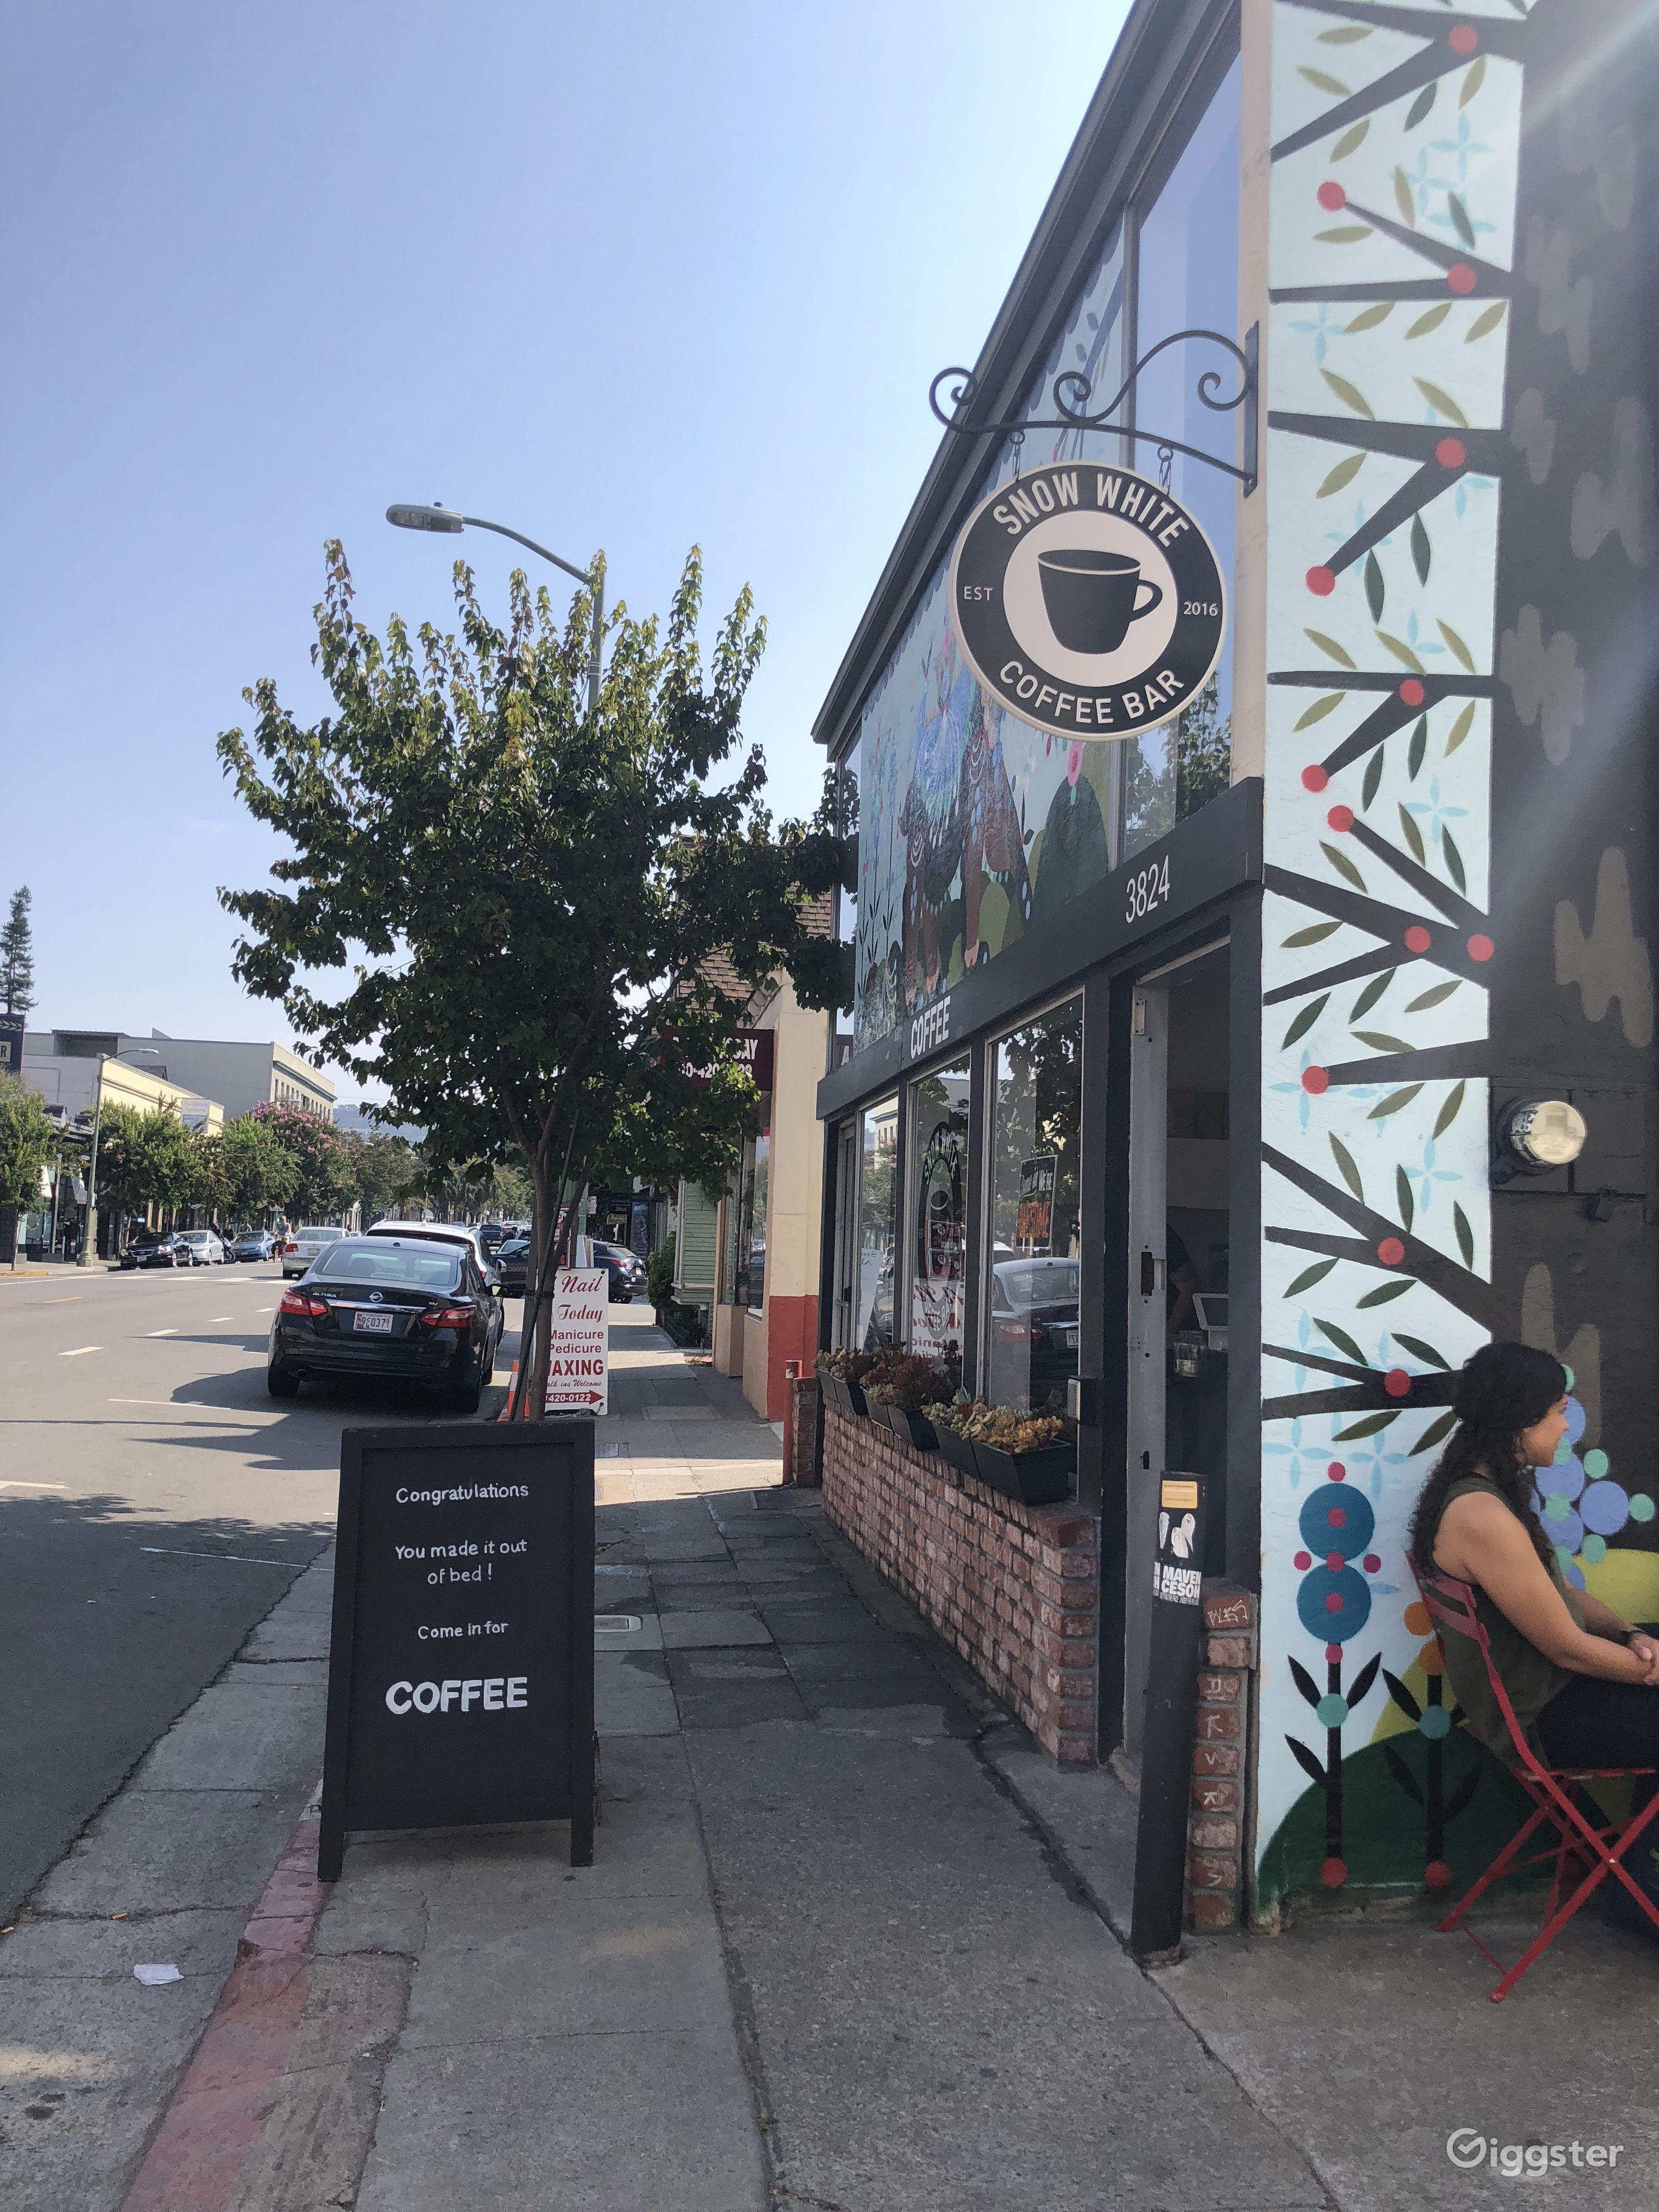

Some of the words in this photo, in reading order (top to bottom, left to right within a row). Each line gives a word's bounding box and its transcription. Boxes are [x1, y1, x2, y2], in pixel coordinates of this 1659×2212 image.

[994, 472, 1079, 535] SNOW
[1097, 473, 1189, 547] WHITE
[964, 586, 993, 601] EST
[1183, 601, 1218, 617] 2016
[1000, 661, 1114, 724] COFFEE
[1122, 669, 1184, 719] BAR
[1126, 855, 1170, 923] 3824
[911, 995, 951, 1059] COFFEE
[562, 1276, 603, 1293] Nail
[557, 1304, 603, 1323] Today
[551, 1329, 604, 1340] Manicure
[550, 1343, 601, 1353] Pedicure
[396, 1482, 529, 1506] Congratulations
[395, 1545, 425, 1560] You
[431, 1540, 478, 1558] made
[484, 1541, 495, 1554] it
[500, 1539, 527, 1554] out
[427, 1568, 445, 1584] of
[1163, 1565, 1201, 1584] MAVEN
[418, 1623, 463, 1639] Come
[468, 1623, 481, 1637] in
[484, 1621, 509, 1635] for
[386, 1677, 528, 1714] COFFEE
